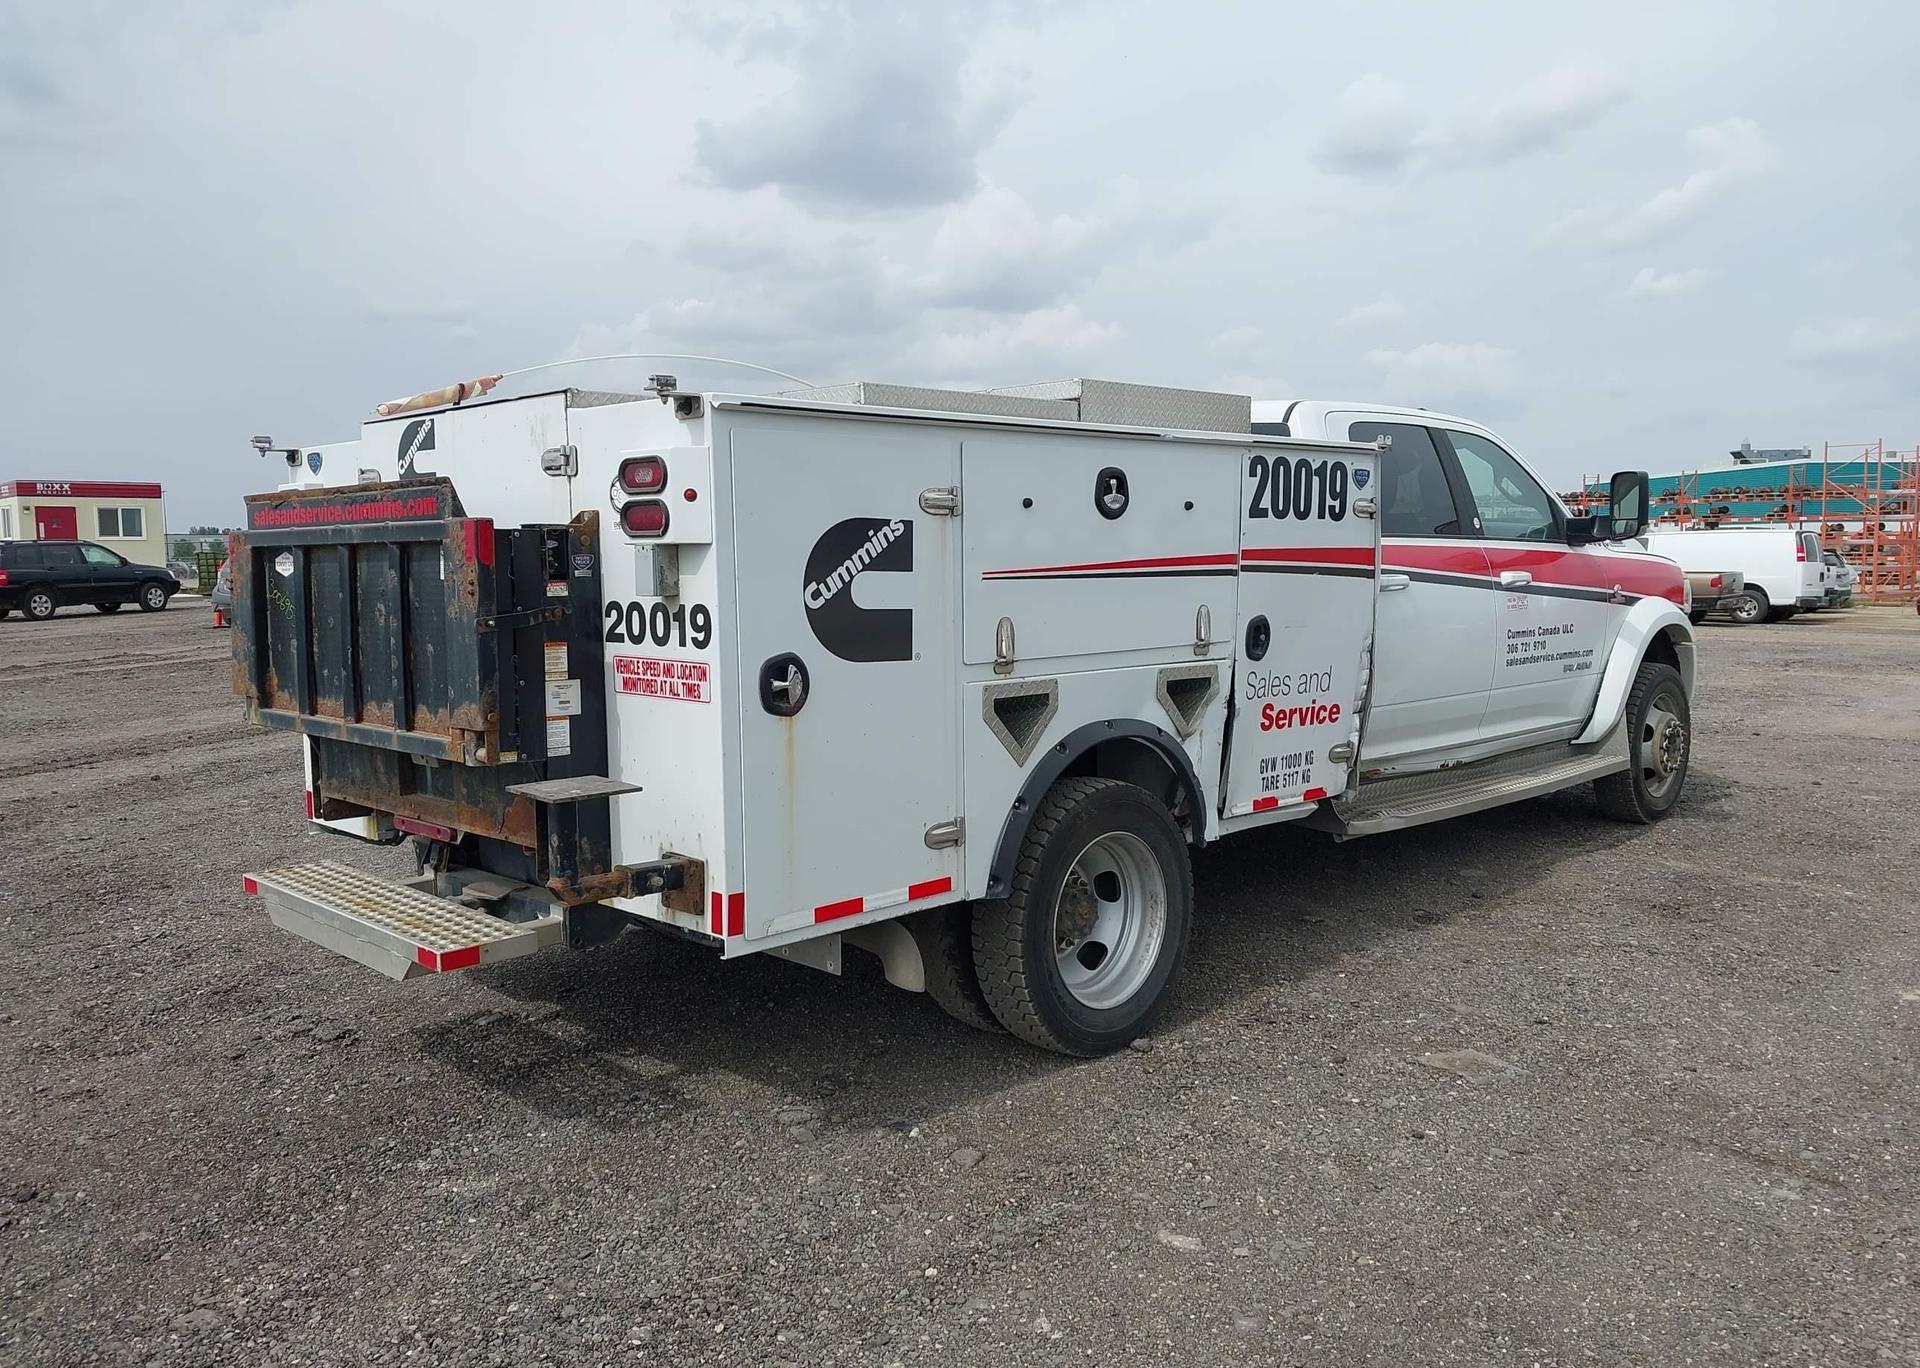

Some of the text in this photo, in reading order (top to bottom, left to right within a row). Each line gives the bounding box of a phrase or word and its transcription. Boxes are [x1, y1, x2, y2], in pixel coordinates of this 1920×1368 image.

[398, 418, 432, 475] Cummins
[36, 483, 71, 491] BOXX
[1248, 455, 1348, 521] 20019
[254, 495, 438, 526] salesandservice.cummins.com
[804, 518, 905, 609] Cummins
[604, 600, 712, 650] 20019
[1507, 623, 1574, 640] Cummins Canada ULC
[1505, 648, 1594, 667] salesandservice.cummins.com
[1506, 640, 1547, 654] 306 721 9710
[615, 658, 707, 683] VEHICLE SPEED AND LOCATION
[1245, 665, 1333, 701] Sales and
[622, 676, 701, 700] MONITORED AT ALL TIMES
[1260, 698, 1341, 732] Service
[1260, 750, 1314, 774] GVW 11000 KG
[1261, 768, 1311, 793] TARE 5117 KG
